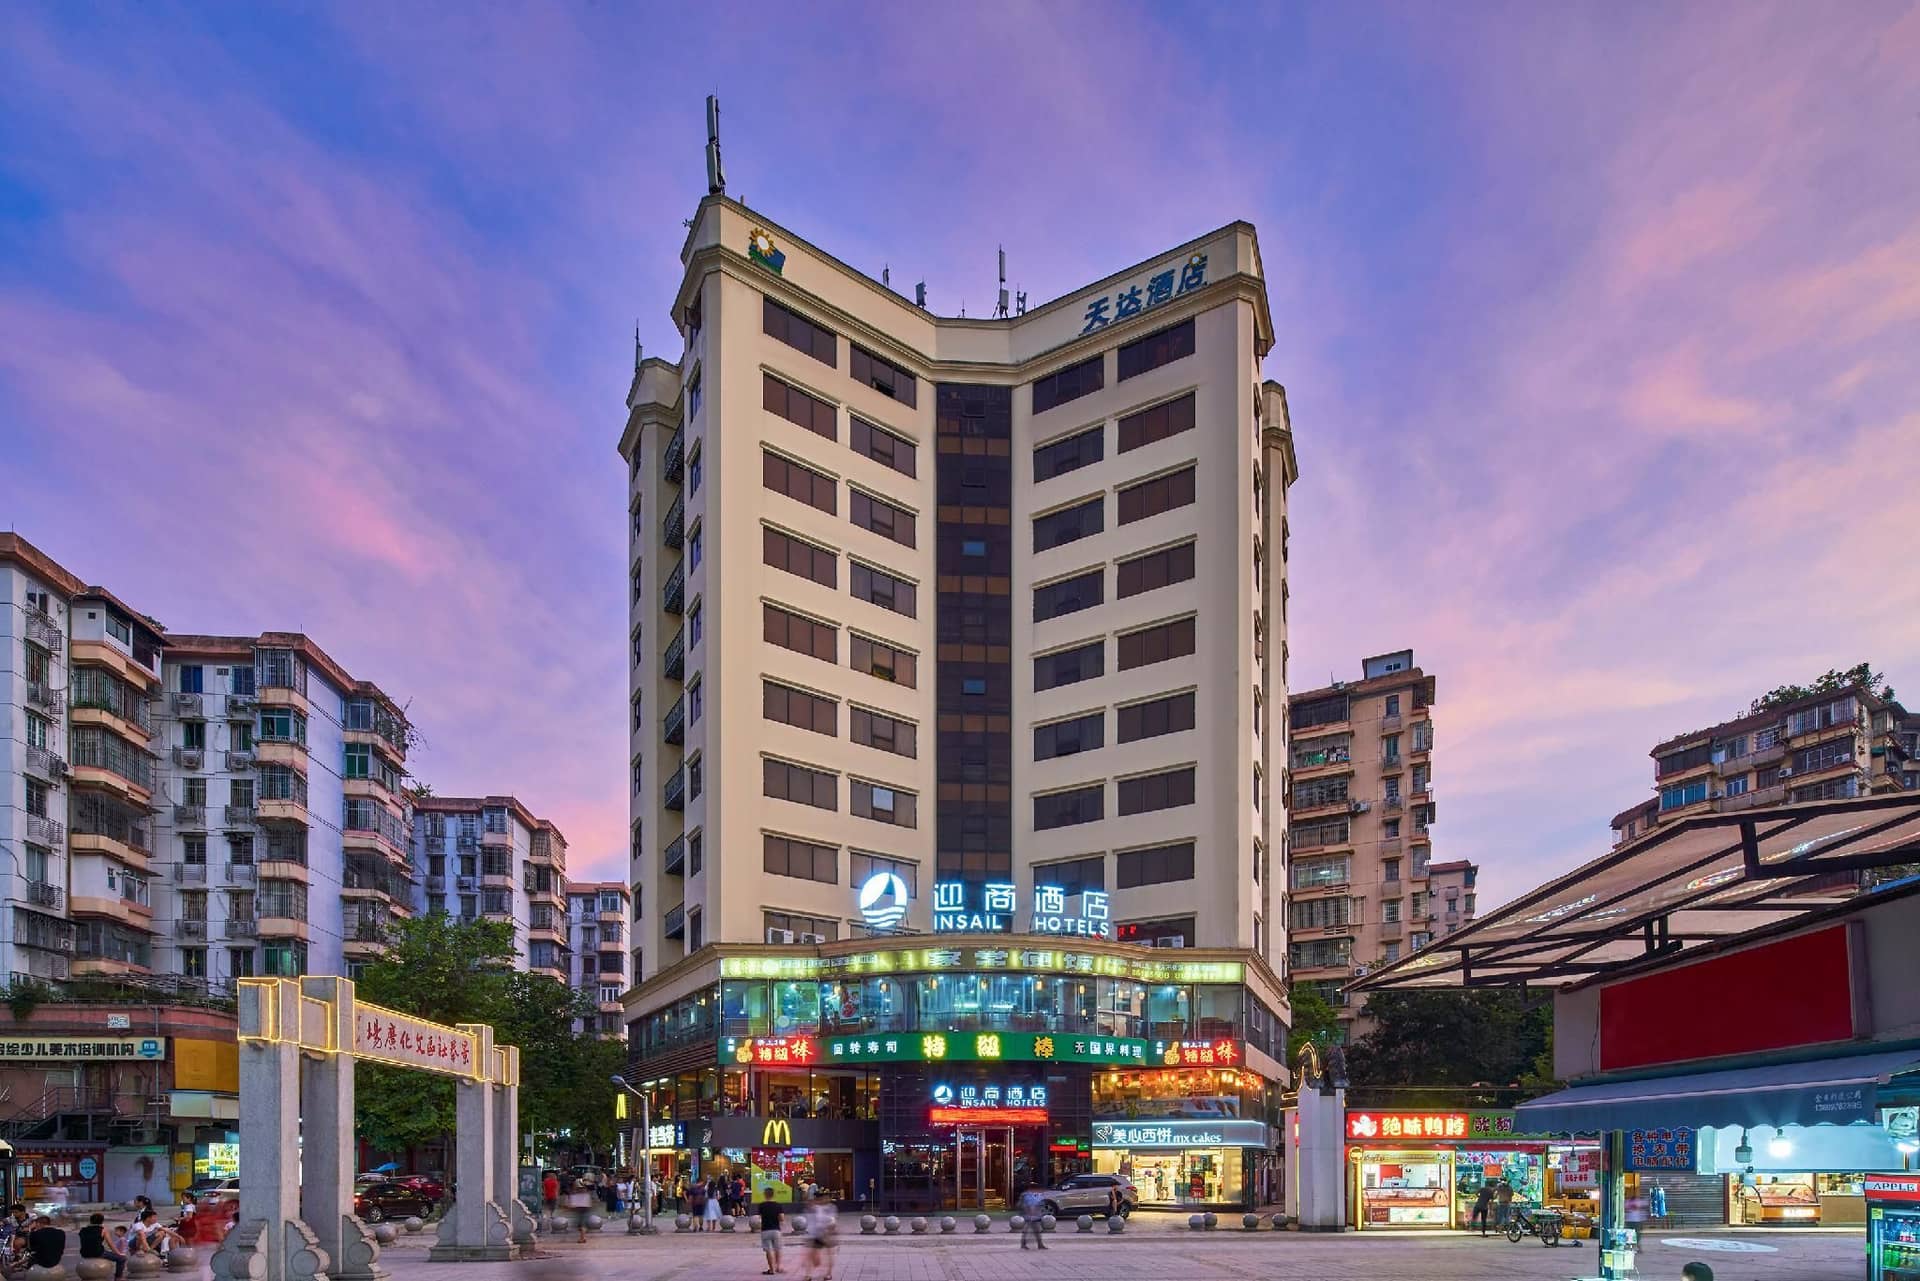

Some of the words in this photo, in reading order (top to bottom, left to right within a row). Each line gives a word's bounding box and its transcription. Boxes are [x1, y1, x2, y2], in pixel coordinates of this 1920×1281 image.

[1081, 254, 1208, 334] 天达酒店
[933, 883, 1109, 920] 迎商酒店
[933, 915, 1003, 930] INSAIL
[1035, 917, 1109, 936] HOTELS
[833, 1040, 898, 1055] 回转寿司
[1074, 1041, 1143, 1059] 无国界料理
[961, 1087, 1046, 1100] 迎商酒店
[962, 1099, 998, 1107] INSAIL
[1006, 1099, 1046, 1107] HOTELS
[1382, 1116, 1466, 1137] 绝味鸭脖
[1112, 1127, 1172, 1144] 美心西饼
[1173, 1135, 1190, 1143] mx
[1192, 1131, 1222, 1144] cakes
[1872, 1182, 1916, 1193] APPLE
